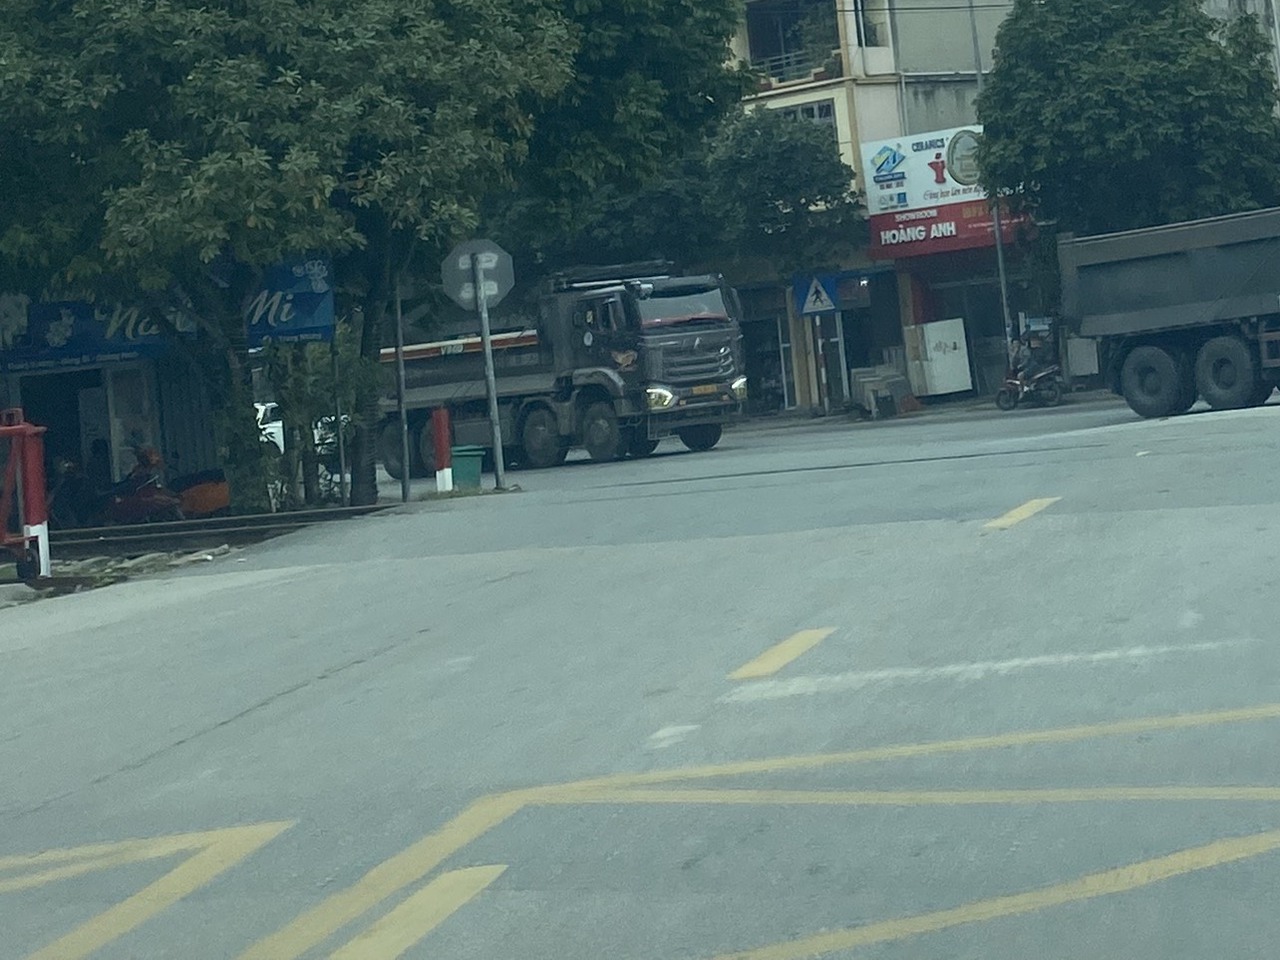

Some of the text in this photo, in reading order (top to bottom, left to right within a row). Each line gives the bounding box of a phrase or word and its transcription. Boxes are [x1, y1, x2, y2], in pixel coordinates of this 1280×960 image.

[911, 138, 945, 152] CERAMICS
[880, 224, 927, 245] HOÀNG
[930, 221, 957, 239] ANH
